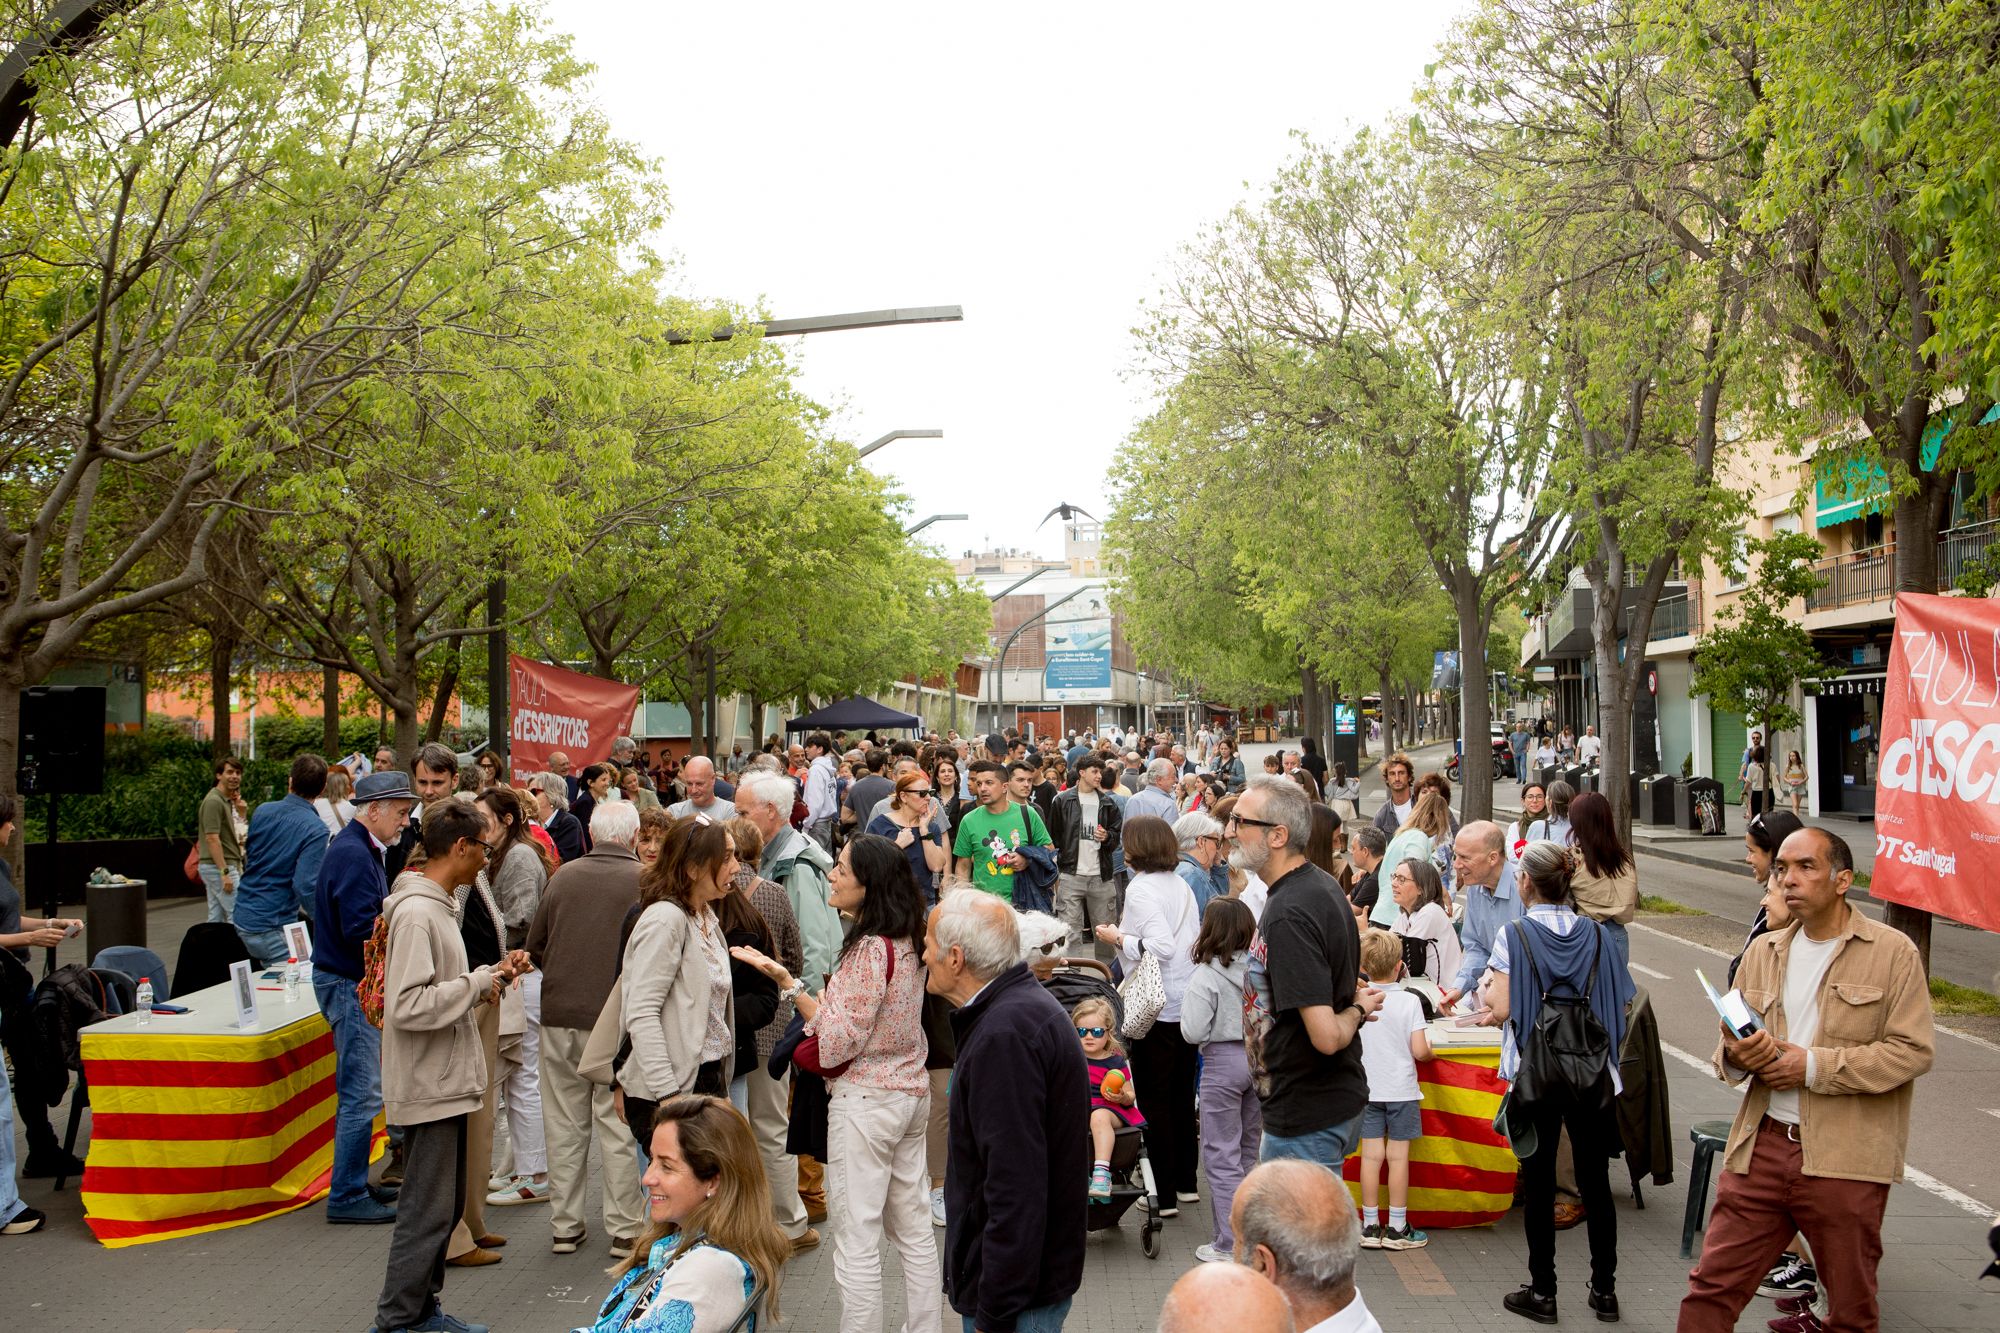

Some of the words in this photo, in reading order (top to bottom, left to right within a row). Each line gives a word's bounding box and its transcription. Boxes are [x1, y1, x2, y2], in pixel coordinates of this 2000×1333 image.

[514, 669, 548, 707] TAULA
[1820, 678, 1886, 696] barberi
[514, 708, 589, 749] d'ESCRIPTORS
